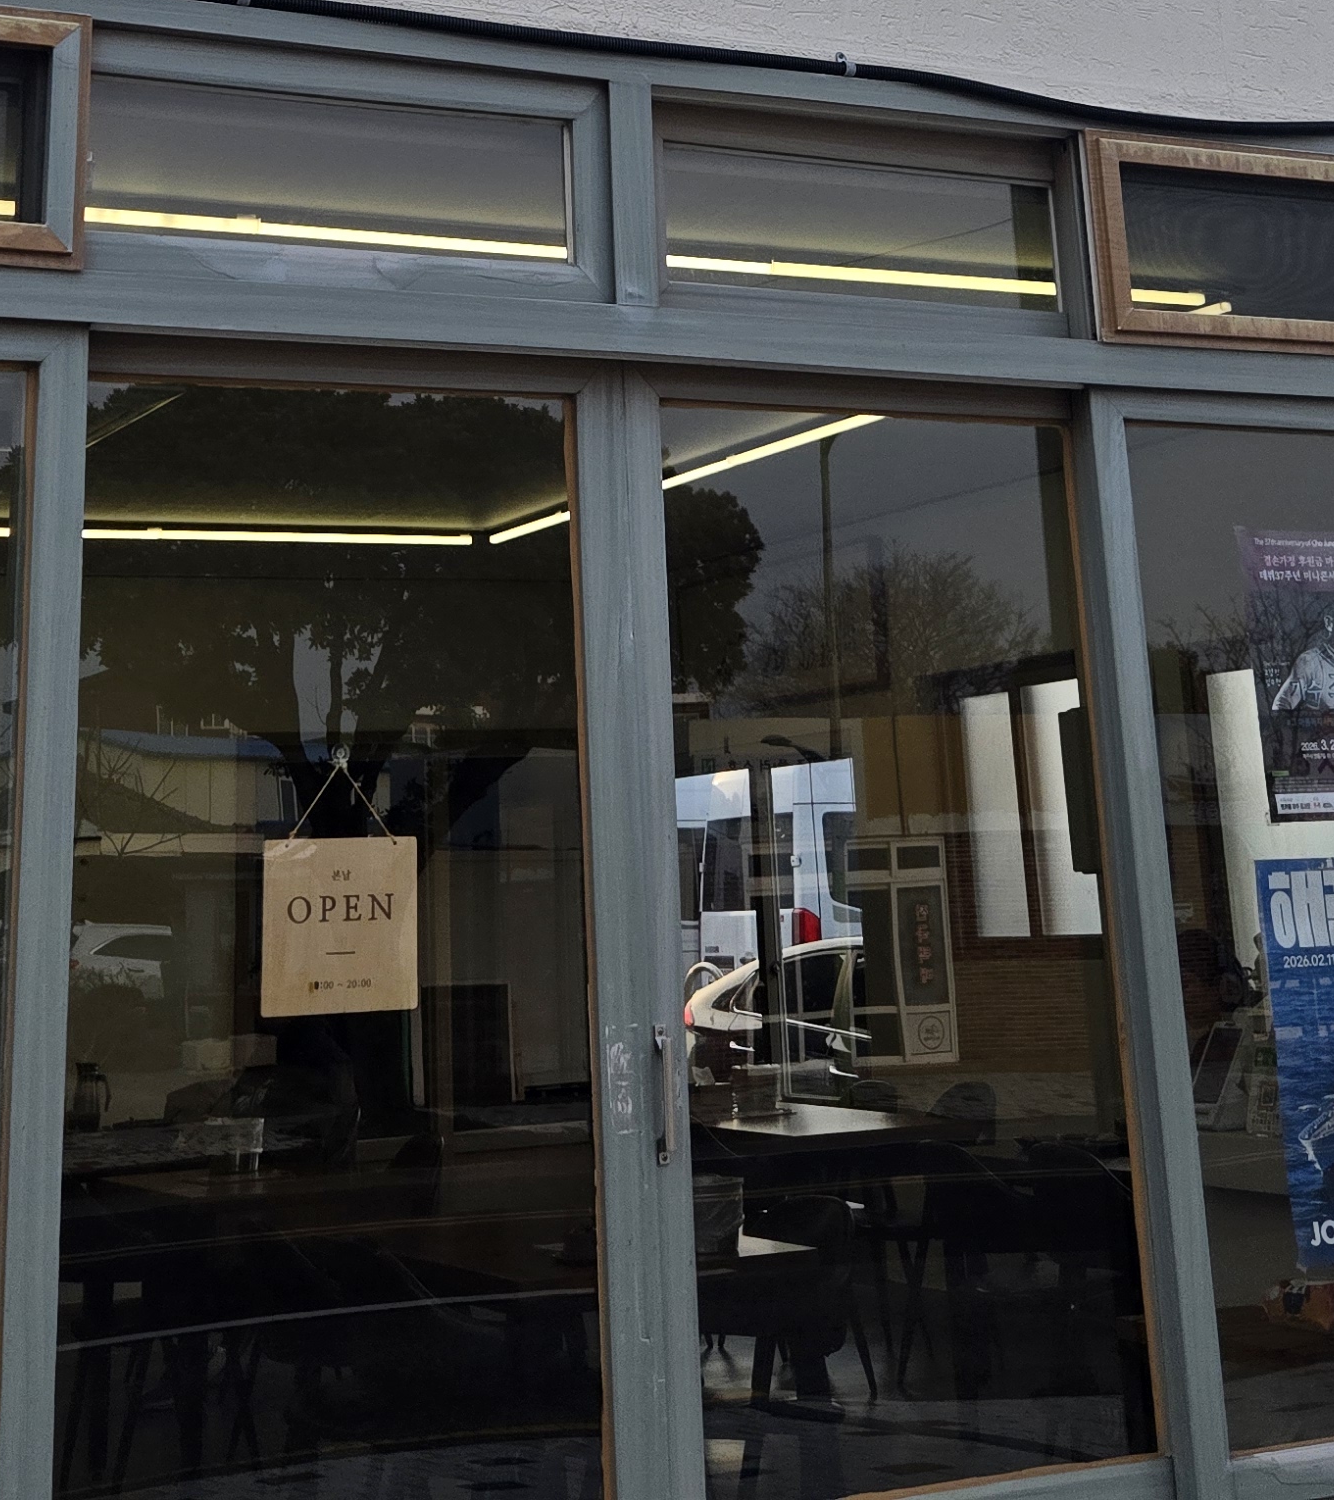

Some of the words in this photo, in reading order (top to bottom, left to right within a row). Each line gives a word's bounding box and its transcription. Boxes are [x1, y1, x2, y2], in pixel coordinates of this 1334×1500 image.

[1290, 679, 1323, 701] 가수
[287, 893, 395, 924] OPEN
[346, 978, 372, 989] 20:00
